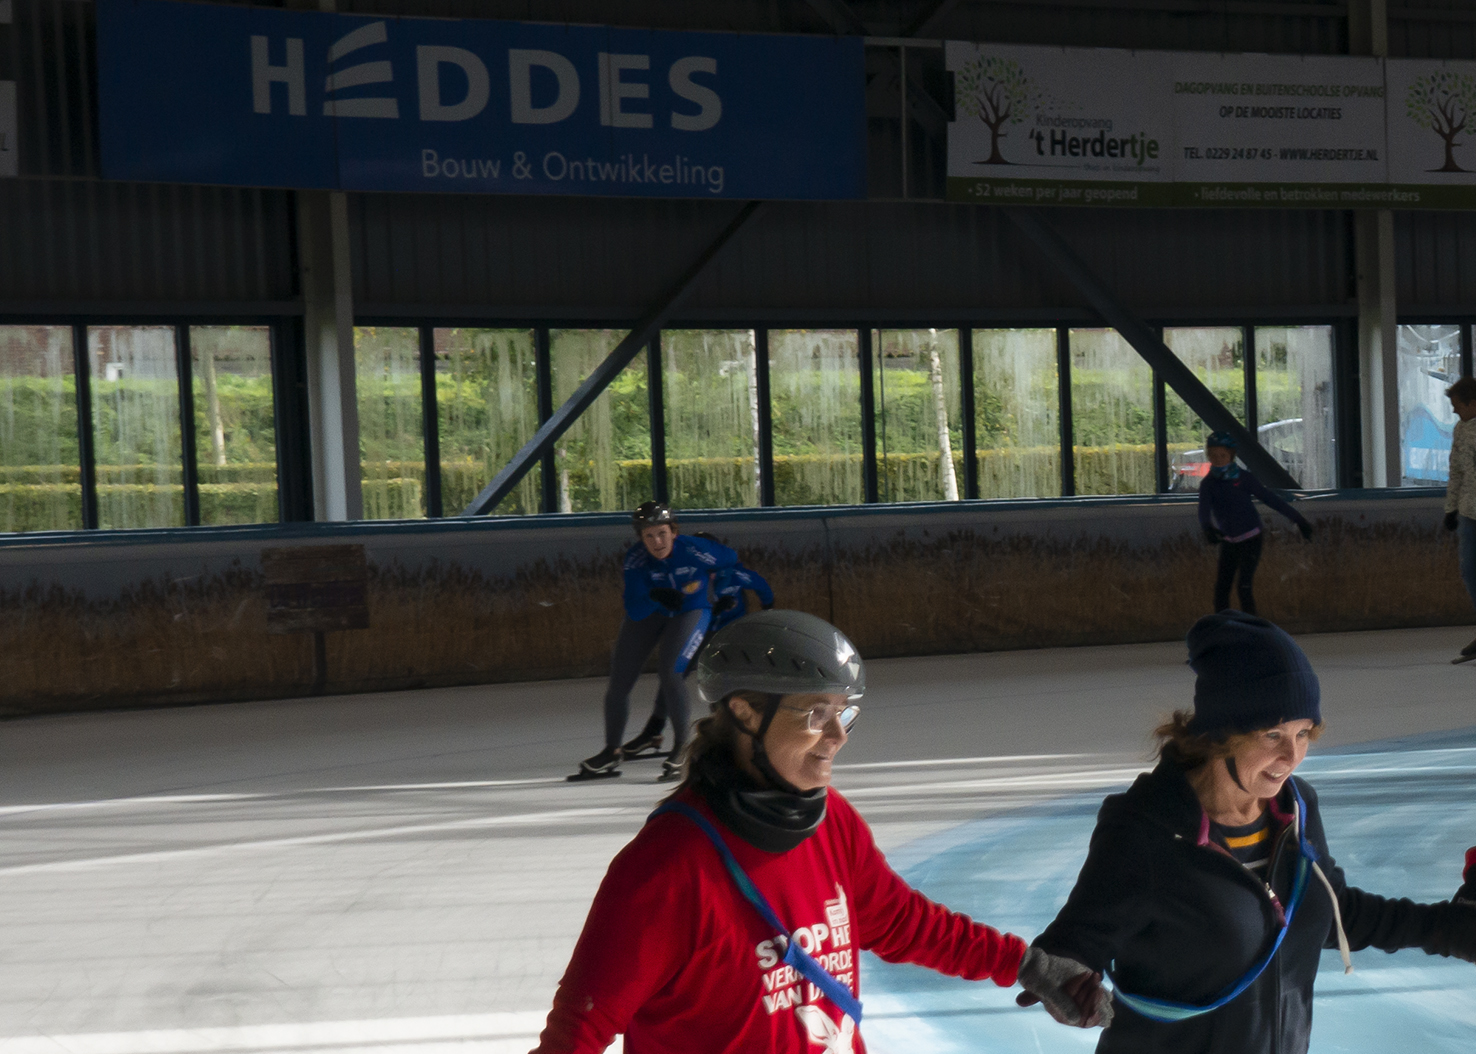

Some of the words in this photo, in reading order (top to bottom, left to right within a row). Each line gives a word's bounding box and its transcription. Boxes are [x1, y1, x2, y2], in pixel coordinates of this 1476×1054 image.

[250, 21, 723, 131] HEDDES
[1174, 81, 1239, 95] DAGOPVANG
[1240, 82, 1254, 95] EN
[1255, 83, 1341, 97] BUITENSCHOOLSE
[1342, 85, 1384, 98] OPVANG
[1219, 105, 1233, 118] OP
[1235, 105, 1249, 118] DE
[1250, 106, 1296, 119] MOOISTE
[1297, 107, 1342, 120] LOCATIES
[1036, 114, 1113, 132] Kinderopvang
[1050, 129, 1159, 166] Herdertje
[1184, 147, 1204, 159] TEL.
[1206, 147, 1230, 160] 0229
[1232, 148, 1244, 160] 24
[1245, 148, 1258, 160] 87
[1260, 148, 1272, 160] 45
[1279, 148, 1379, 161] WWW.HERDERTJE.NL
[421, 149, 500, 179] Bouw
[512, 151, 532, 179] &
[543, 151, 725, 193] Ontwikkeling
[975, 183, 991, 197] 52
[993, 183, 1033, 198] weken
[1035, 187, 1056, 201] per
[1058, 185, 1082, 201] jaar
[1085, 186, 1138, 203] geopend
[1200, 187, 1262, 201] liefdevolle
[1263, 190, 1278, 201] en
[1279, 188, 1338, 201] betrokken
[1340, 188, 1420, 203] medewerkers
